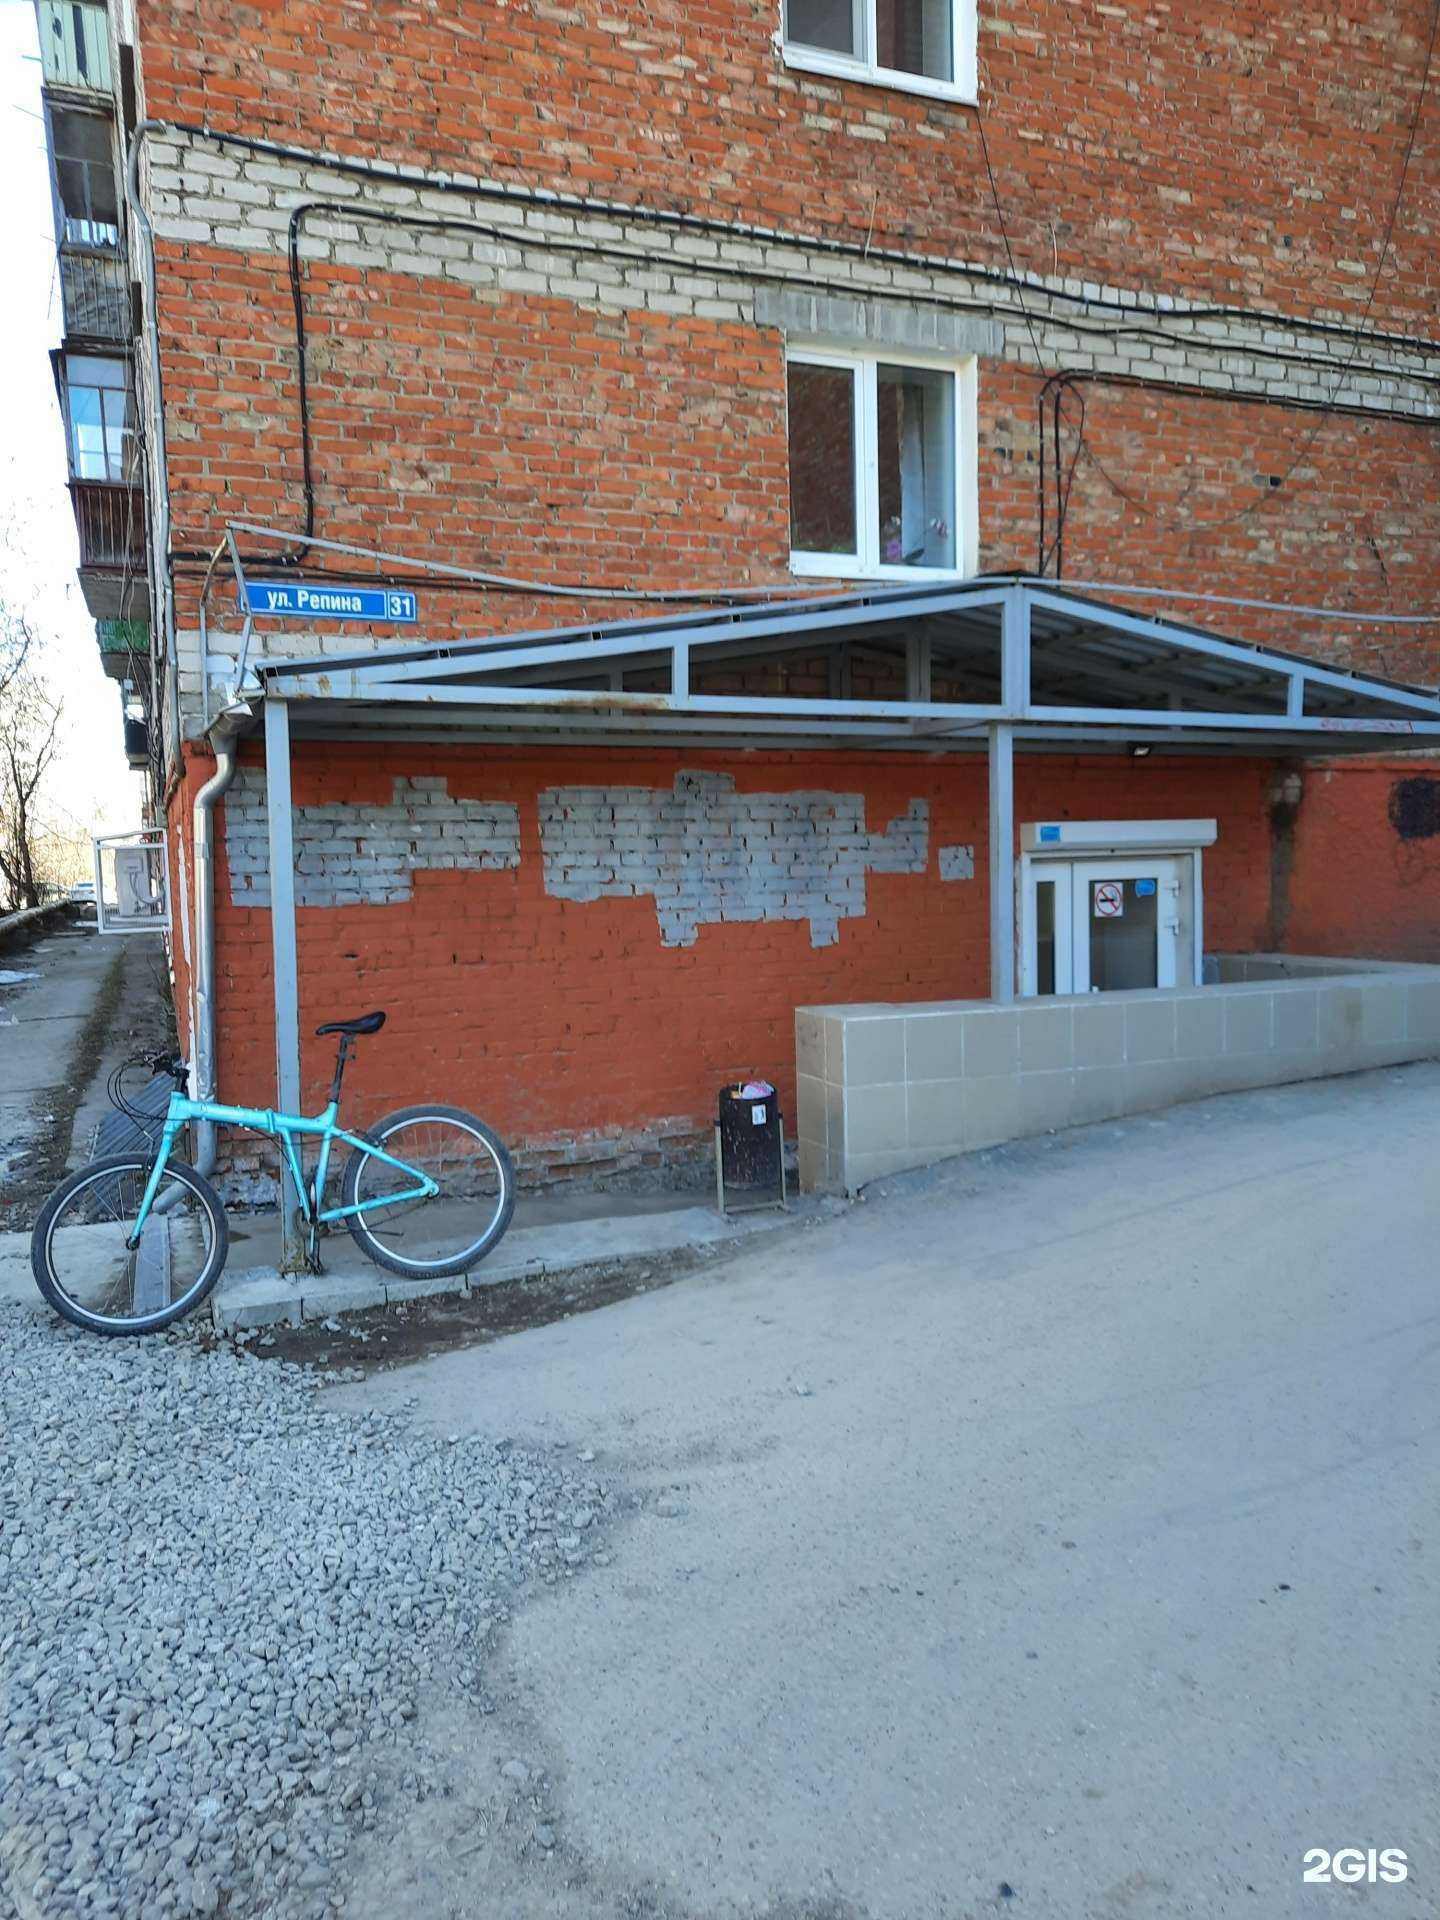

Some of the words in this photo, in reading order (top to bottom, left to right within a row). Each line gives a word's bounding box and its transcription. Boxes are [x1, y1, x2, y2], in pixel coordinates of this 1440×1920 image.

[267, 591, 292, 609] ул.
[298, 590, 362, 612] Репина
[391, 596, 411, 617] 31
